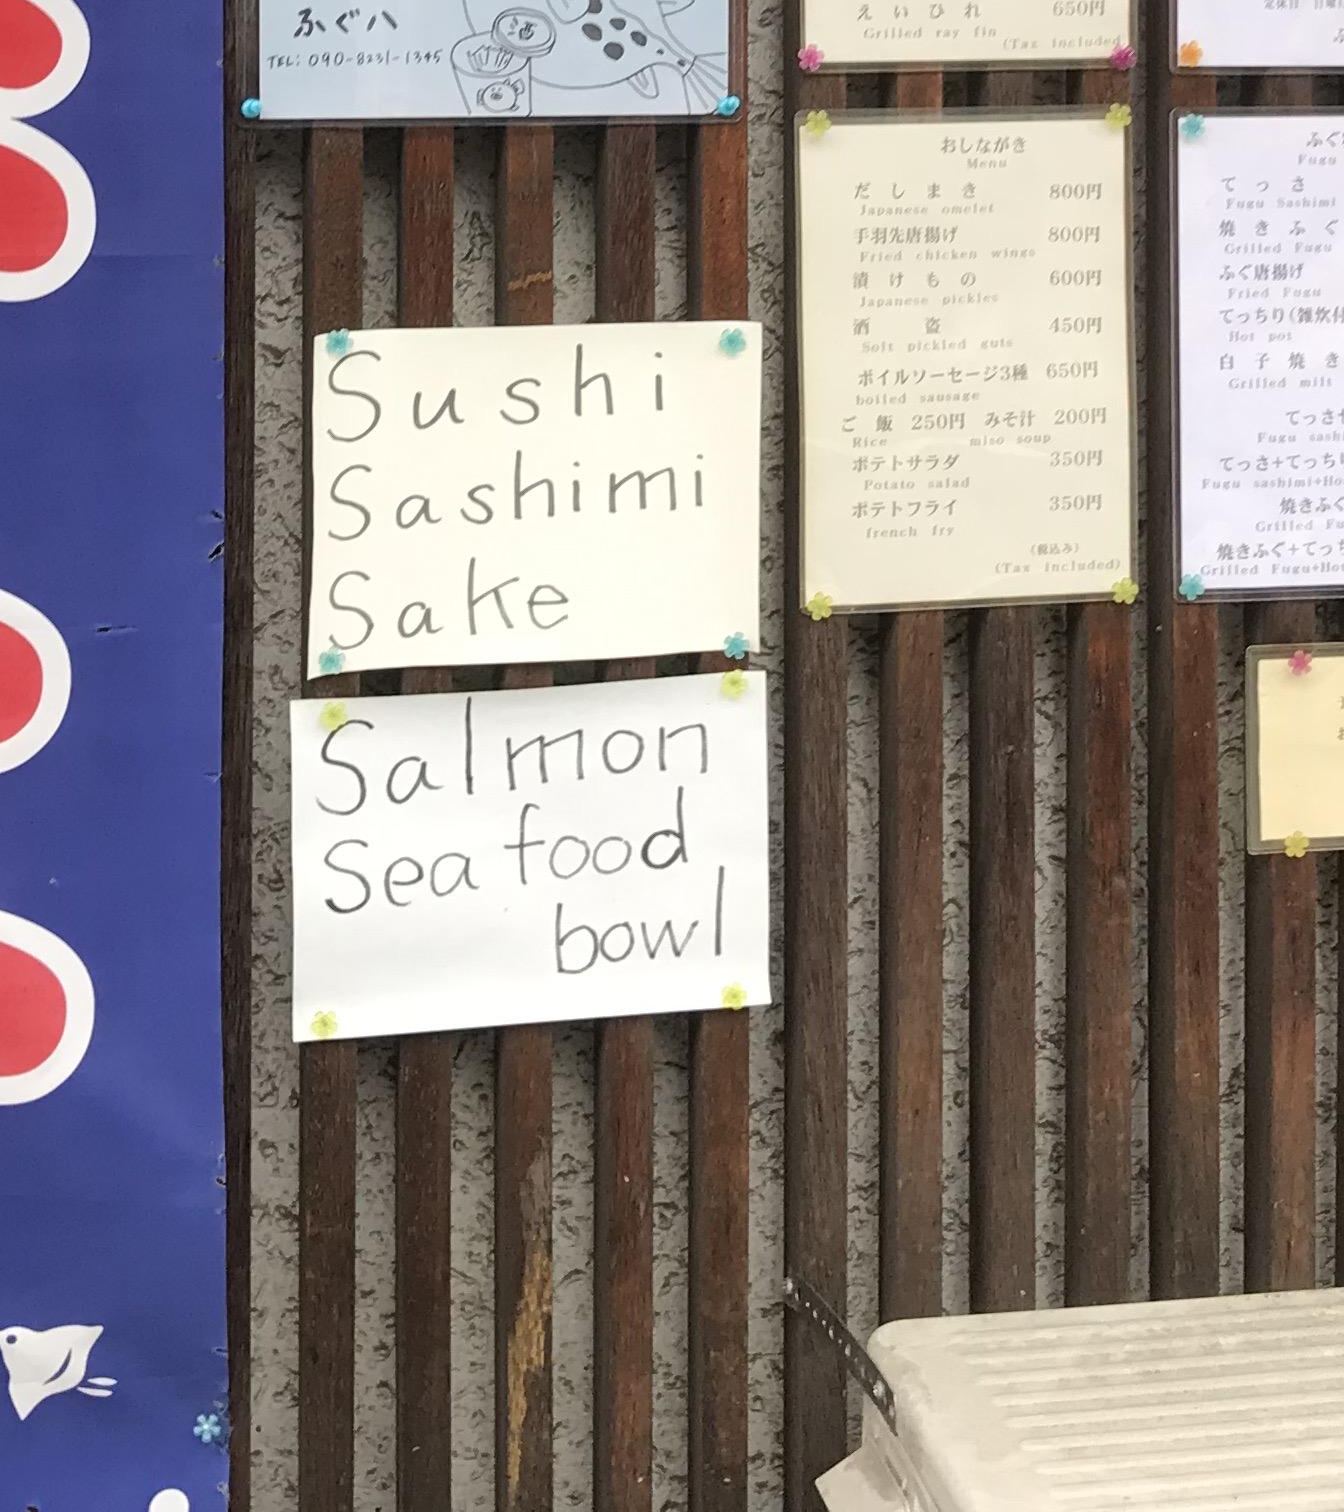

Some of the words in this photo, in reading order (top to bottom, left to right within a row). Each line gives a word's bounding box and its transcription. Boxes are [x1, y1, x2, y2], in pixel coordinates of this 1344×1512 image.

[858, 1, 981, 20] えいひれ
[1053, 0, 1105, 17] 650円
[941, 136, 1027, 154] おしながき
[967, 157, 1007, 169] Menu
[854, 182, 976, 199] だしまき
[1049, 183, 1103, 200] 800円
[856, 226, 957, 244] 手羽先唐揚げ
[1048, 226, 1100, 243] 800円
[853, 271, 976, 289] 漬けもの
[1049, 269, 1102, 287] 600円
[1048, 316, 1102, 333] 450円
[1046, 362, 1098, 378] 650円
[1220, 352, 1339, 370] 白子焼き
[326, 343, 665, 442] Sushi
[912, 413, 965, 430] 250円
[985, 410, 1035, 428] みそ汁
[1054, 408, 1107, 425] 200円
[852, 437, 887, 448] Rice
[970, 434, 1006, 446] miso
[1016, 433, 1052, 445] soup
[852, 454, 960, 473] ポテトサラダ
[1050, 450, 1103, 467] 350円
[864, 479, 915, 491] Potato
[928, 476, 970, 489] salad
[327, 449, 705, 541] Sashimi
[852, 499, 957, 519] ポテトフライ
[1049, 494, 1102, 511] 350円
[327, 556, 570, 651] Sake
[315, 696, 709, 816] Salmon
[556, 865, 724, 974] bowl
